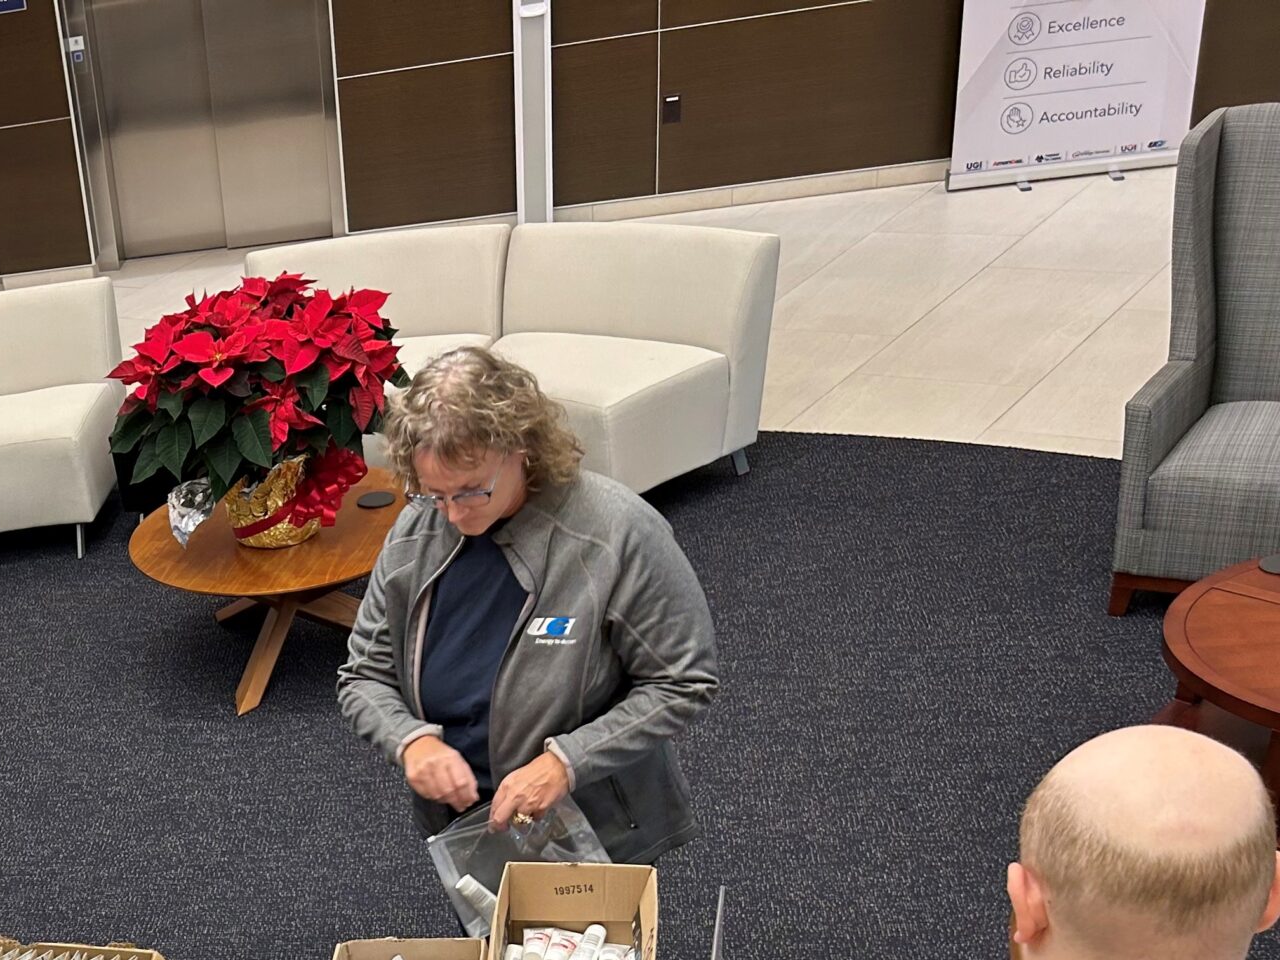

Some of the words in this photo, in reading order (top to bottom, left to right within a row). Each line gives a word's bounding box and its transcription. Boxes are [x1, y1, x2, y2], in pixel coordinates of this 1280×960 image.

[1047, 16, 1125, 34] Excellence
[1043, 61, 1114, 80] Reliability
[1039, 102, 1142, 124] Accountability
[966, 160, 983, 170] UGI
[553, 884, 594, 896] 1997514
